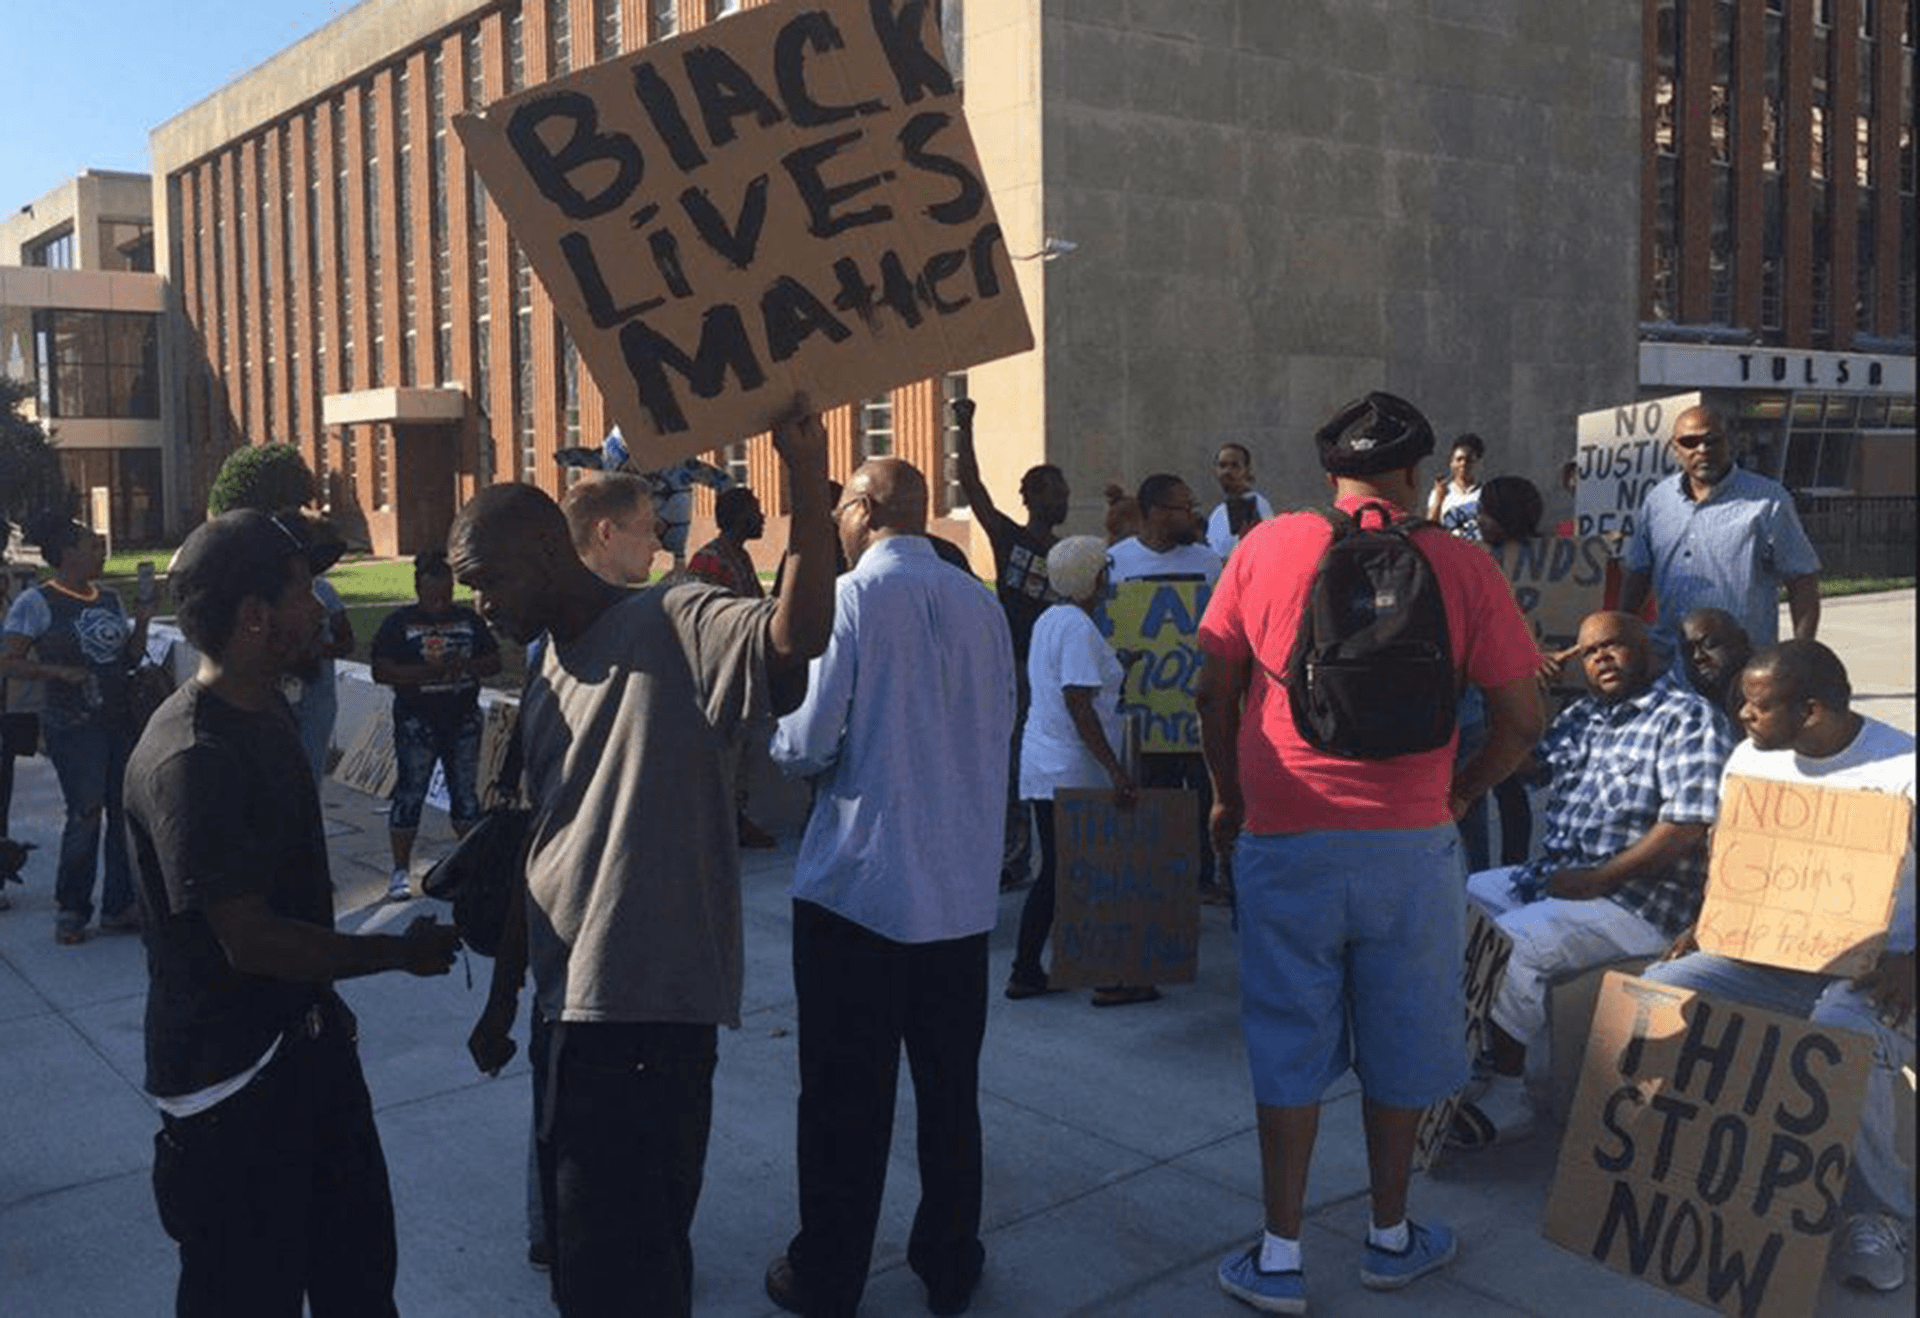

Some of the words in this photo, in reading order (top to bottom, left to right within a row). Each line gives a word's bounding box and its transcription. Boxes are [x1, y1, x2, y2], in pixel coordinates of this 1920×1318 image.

[506, 0, 955, 220] BlACK
[559, 111, 984, 331] LiVES
[618, 223, 1001, 435] MAtter
[1737, 353, 1884, 387] TULSA
[1578, 439, 1676, 481] JUSTIC
[1615, 402, 1663, 436] NO
[1493, 535, 1612, 588] NDS
[1578, 513, 1637, 538] PEA
[1618, 980, 1844, 1137] THIS
[1593, 1085, 1848, 1237] STOPS
[1593, 1180, 1785, 1318] NOW
